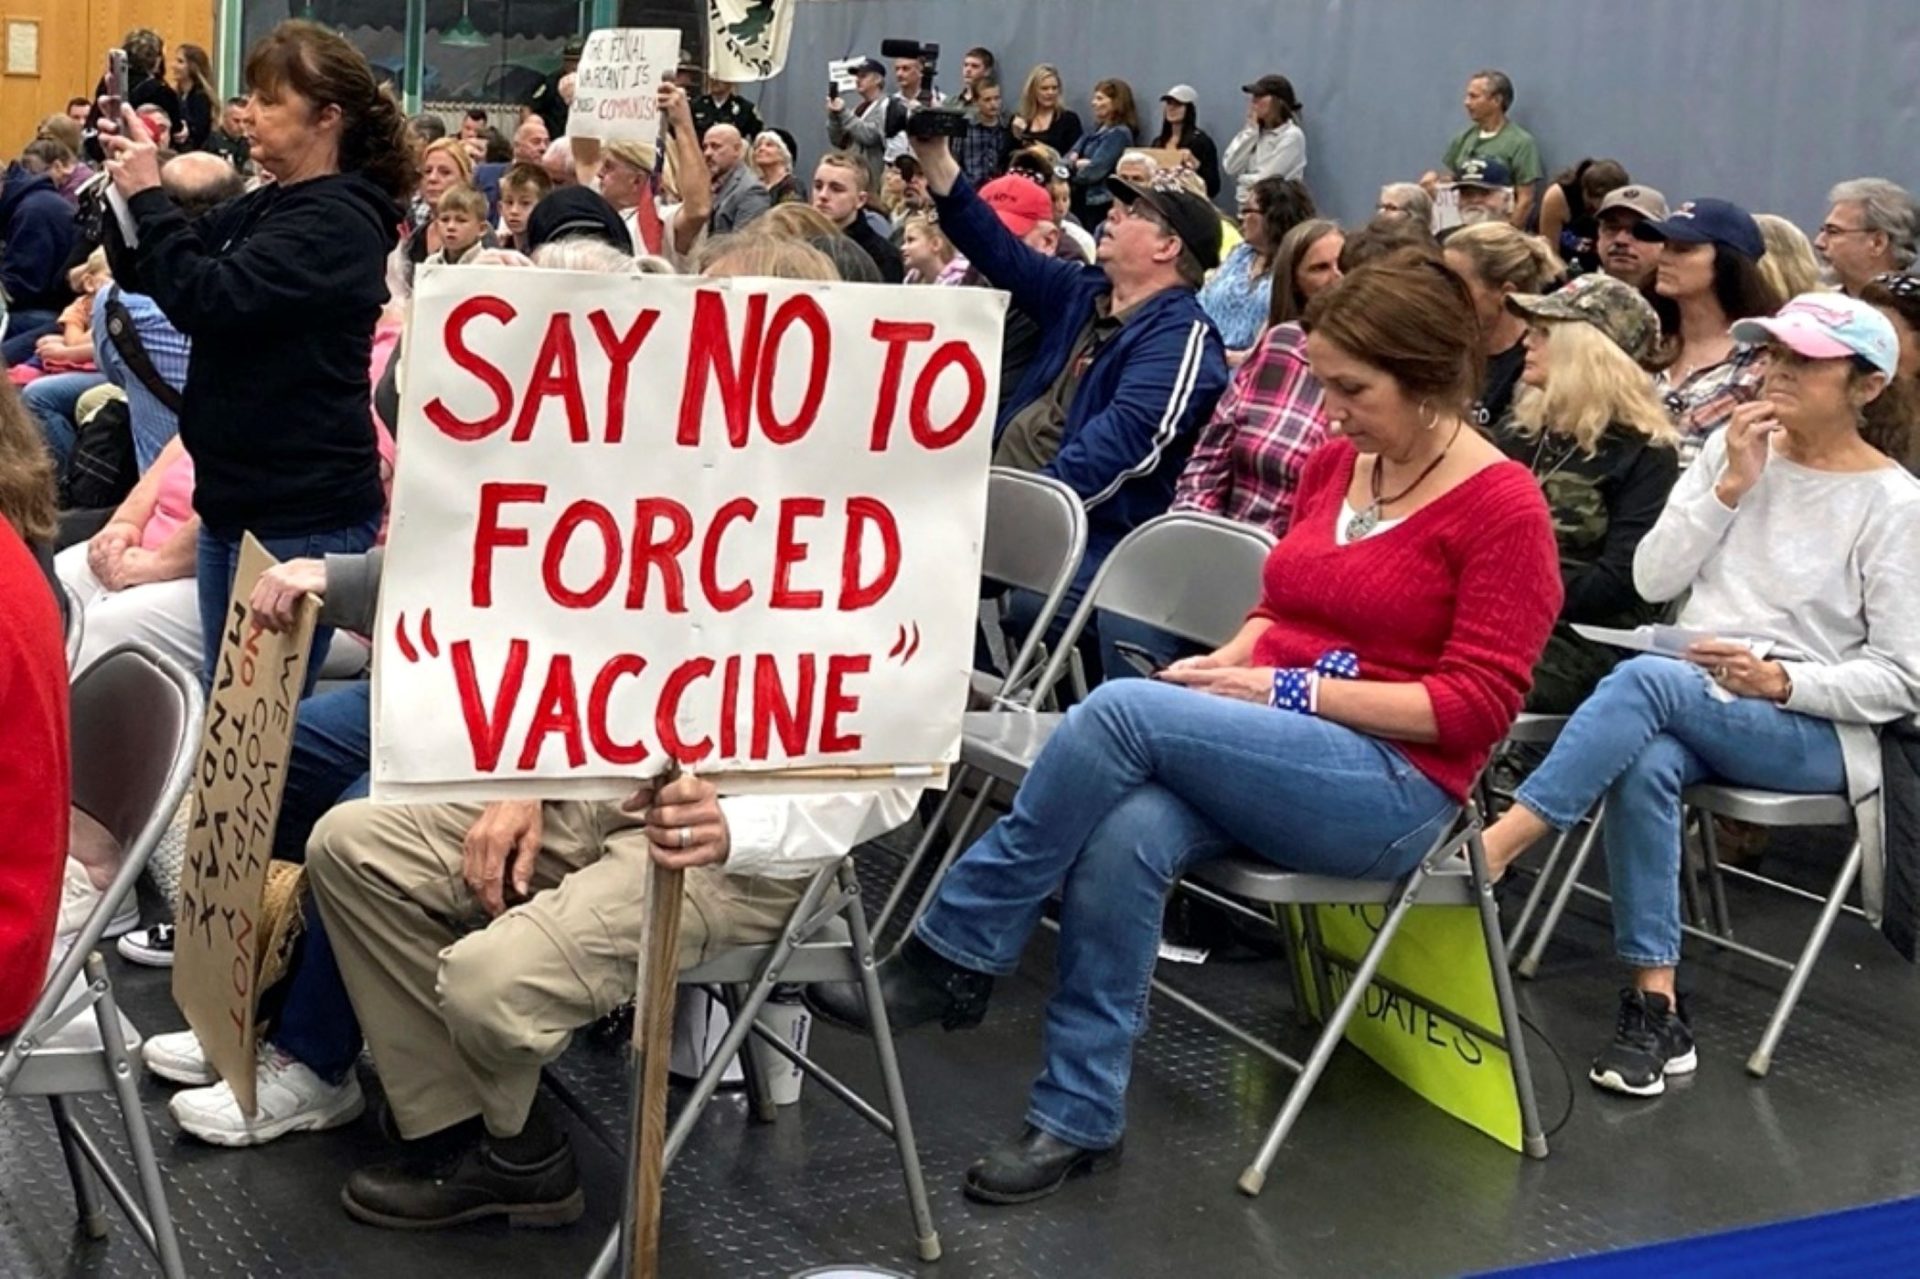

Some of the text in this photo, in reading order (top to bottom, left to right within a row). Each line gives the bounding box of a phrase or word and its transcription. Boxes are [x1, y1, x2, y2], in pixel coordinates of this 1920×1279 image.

[631, 64, 650, 87] IS
[423, 290, 987, 452] SAY NO TO
[470, 482, 902, 613] FORCED
[182, 600, 247, 936] MANDATE
[199, 622, 263, 949] NO TO VAX
[222, 697, 268, 940] COMPLY
[229, 653, 298, 1047] WE WILL NOT
